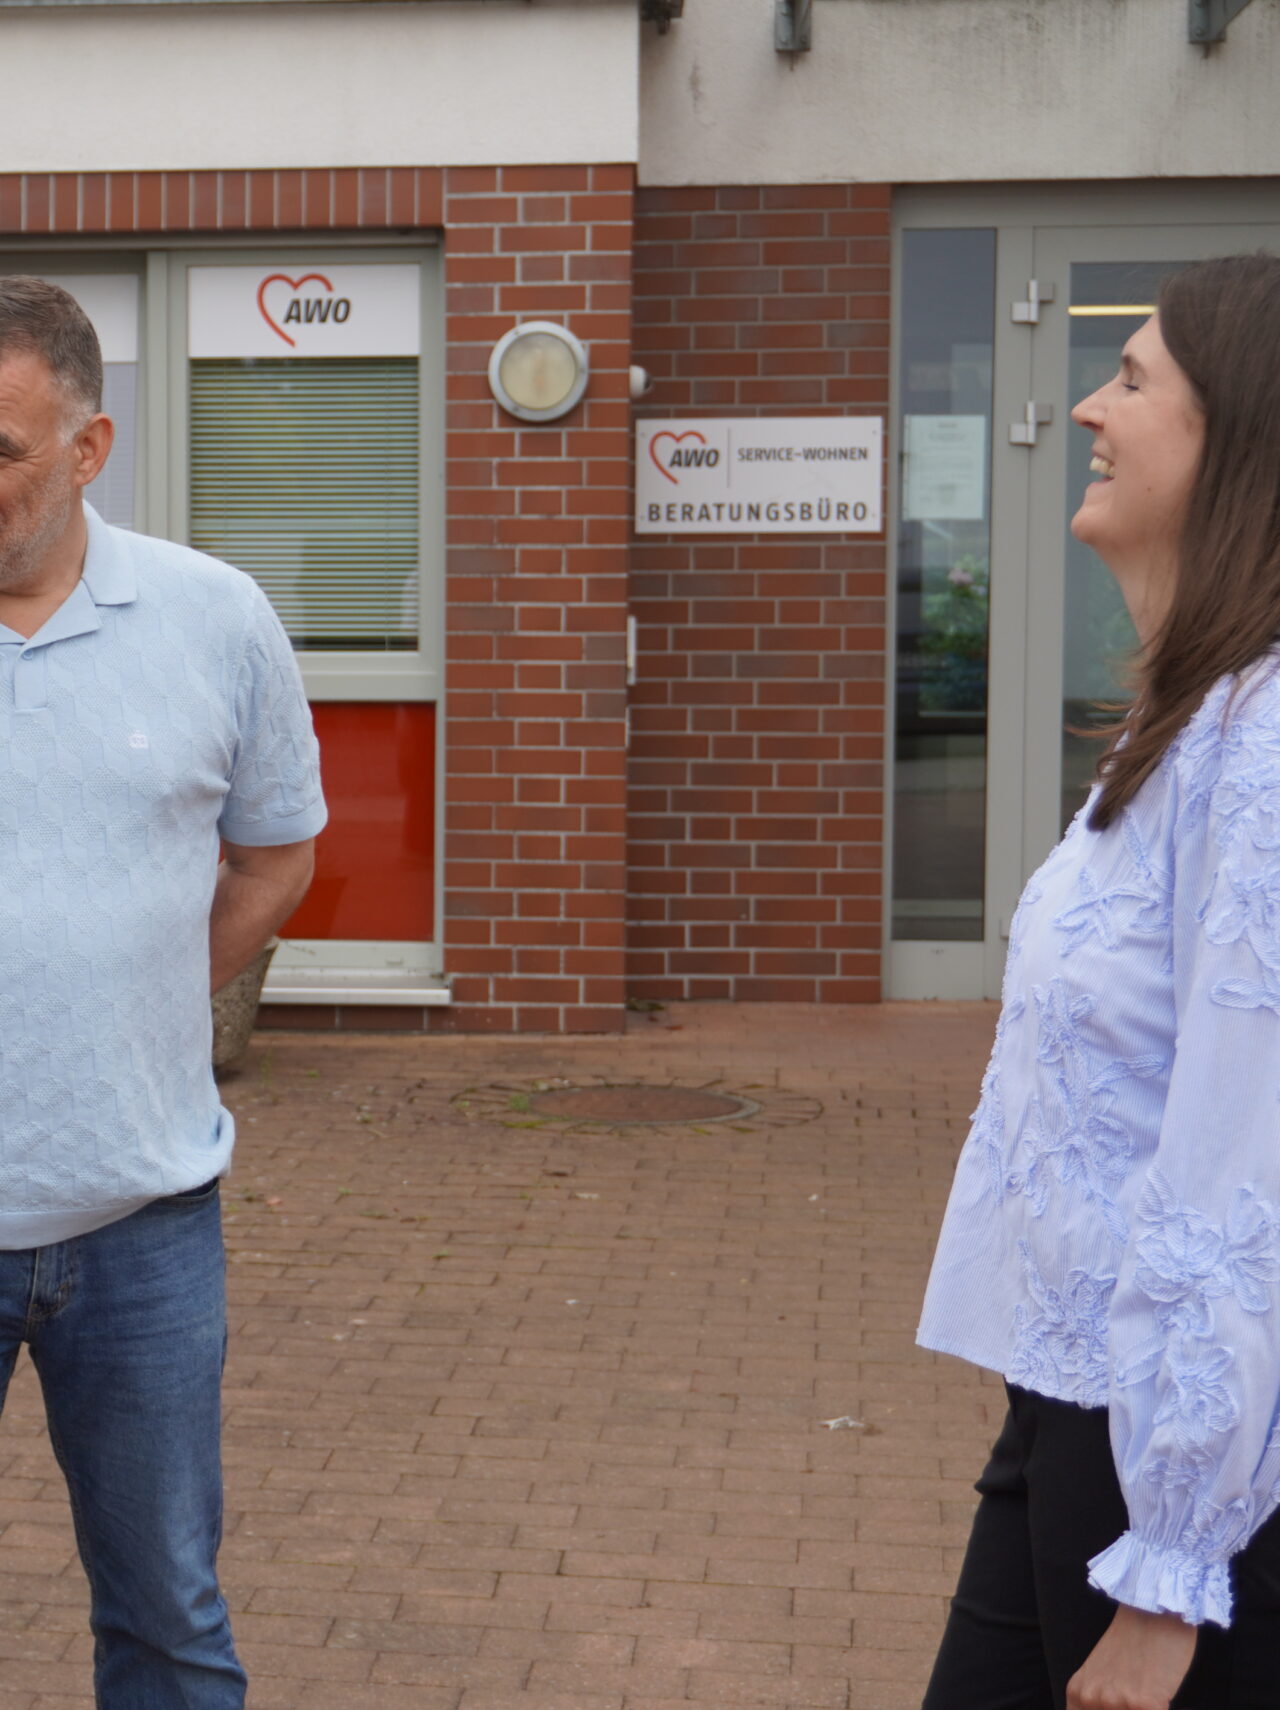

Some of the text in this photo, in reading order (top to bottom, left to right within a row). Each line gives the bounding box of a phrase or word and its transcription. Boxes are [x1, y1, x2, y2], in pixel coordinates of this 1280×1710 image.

[283, 298, 351, 324] AWO
[669, 448, 719, 468] AWO
[737, 446, 869, 462] SERVICE-WOHNEN
[647, 498, 867, 523] BERATUNGSBÜRO
